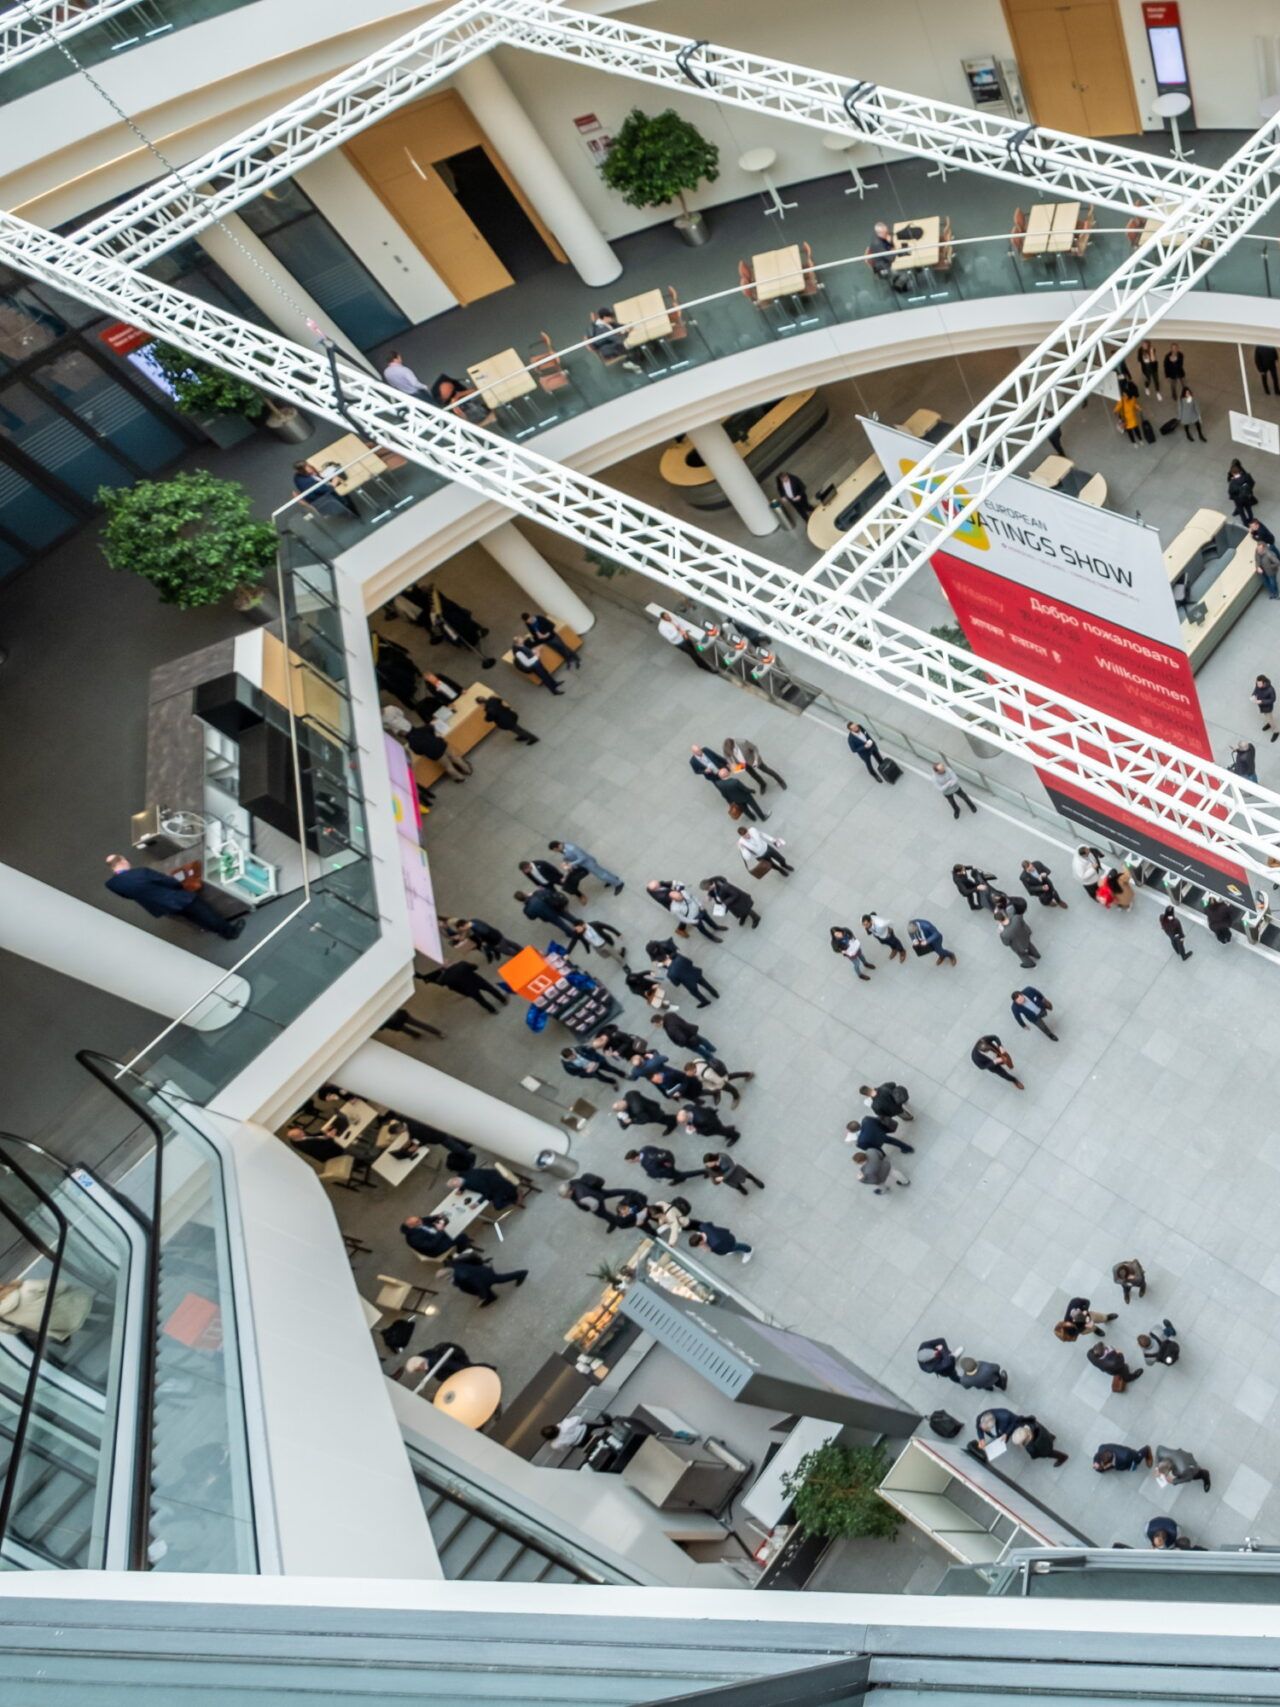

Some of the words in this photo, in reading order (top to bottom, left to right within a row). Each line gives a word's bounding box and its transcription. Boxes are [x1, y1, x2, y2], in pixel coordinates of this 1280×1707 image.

[984, 500, 1048, 532] EUROPEAN
[1060, 544, 1132, 588] SHOW
[1029, 597, 1079, 627] Добро
[1082, 621, 1180, 669] пожаловать
[1094, 654, 1191, 705] Willkommen
